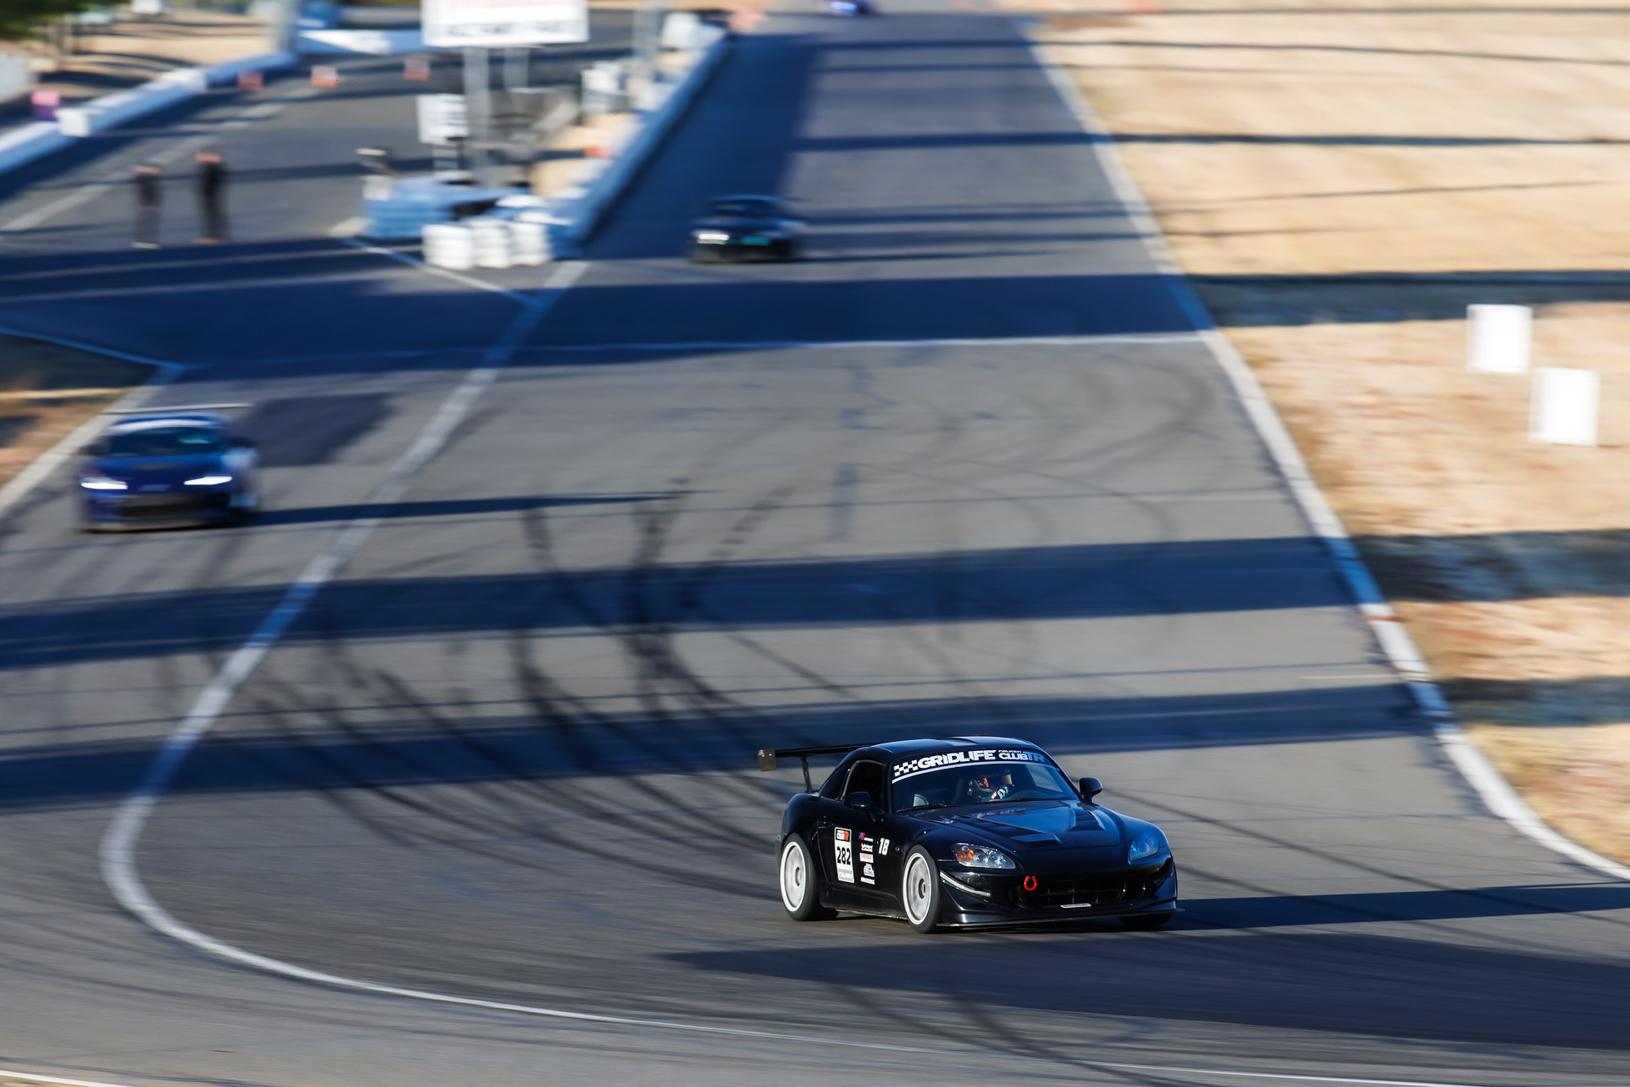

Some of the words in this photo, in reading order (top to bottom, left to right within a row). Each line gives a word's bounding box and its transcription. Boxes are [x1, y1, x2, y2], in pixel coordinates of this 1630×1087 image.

[917, 749, 997, 770] GRIDLIFE
[836, 846, 851, 866] 282
[878, 837, 890, 856] 18
